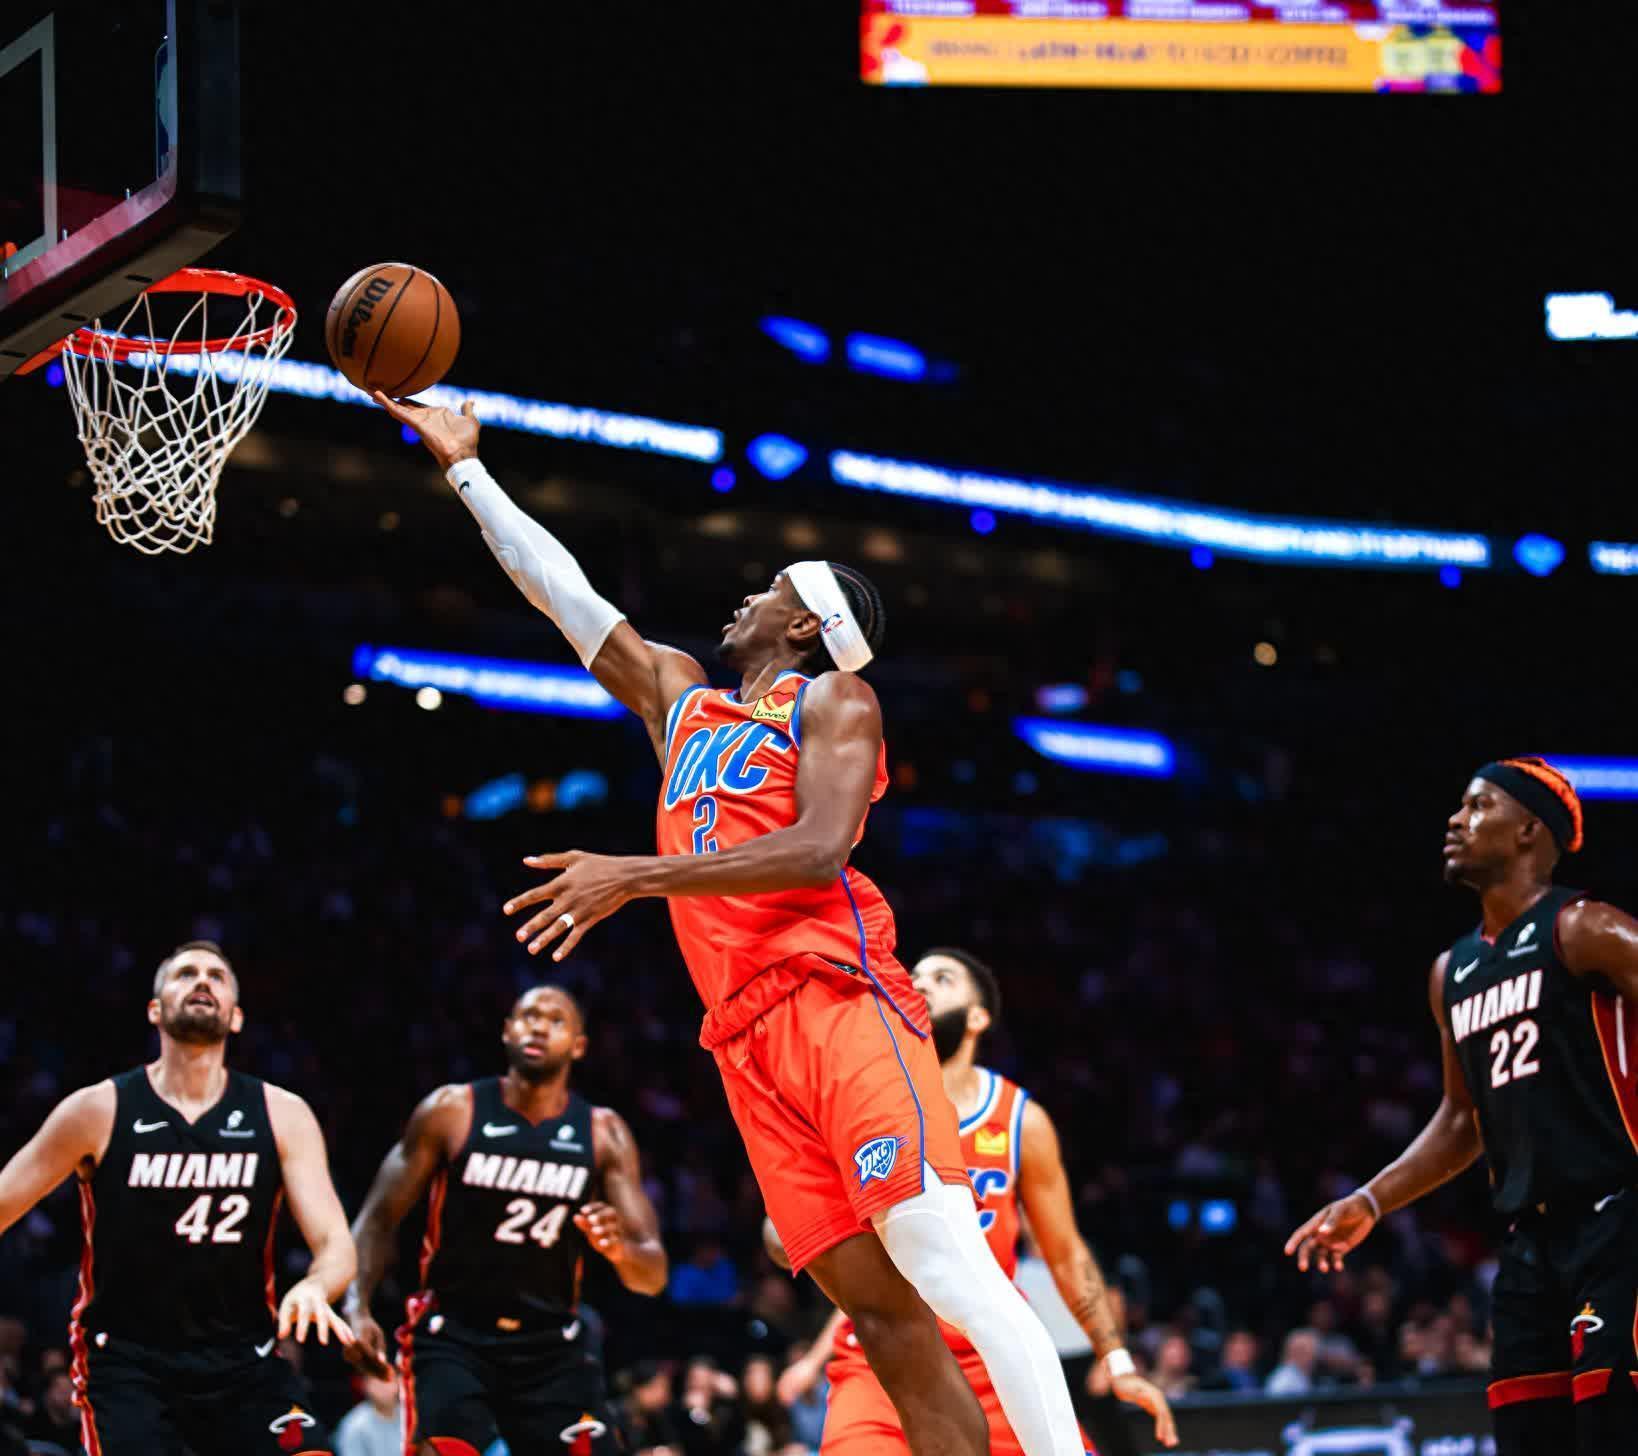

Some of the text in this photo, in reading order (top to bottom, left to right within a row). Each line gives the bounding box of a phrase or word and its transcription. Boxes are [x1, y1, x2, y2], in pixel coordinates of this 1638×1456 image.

[664, 721, 793, 812] OKC
[693, 794, 718, 855] 2
[1451, 969, 1543, 1043] MIAMI
[1490, 1018, 1540, 1089] 22
[128, 1153, 259, 1188] MIAMI
[462, 1152, 589, 1200] MIAMI
[175, 1194, 250, 1243] 42
[494, 1198, 569, 1248] 24
